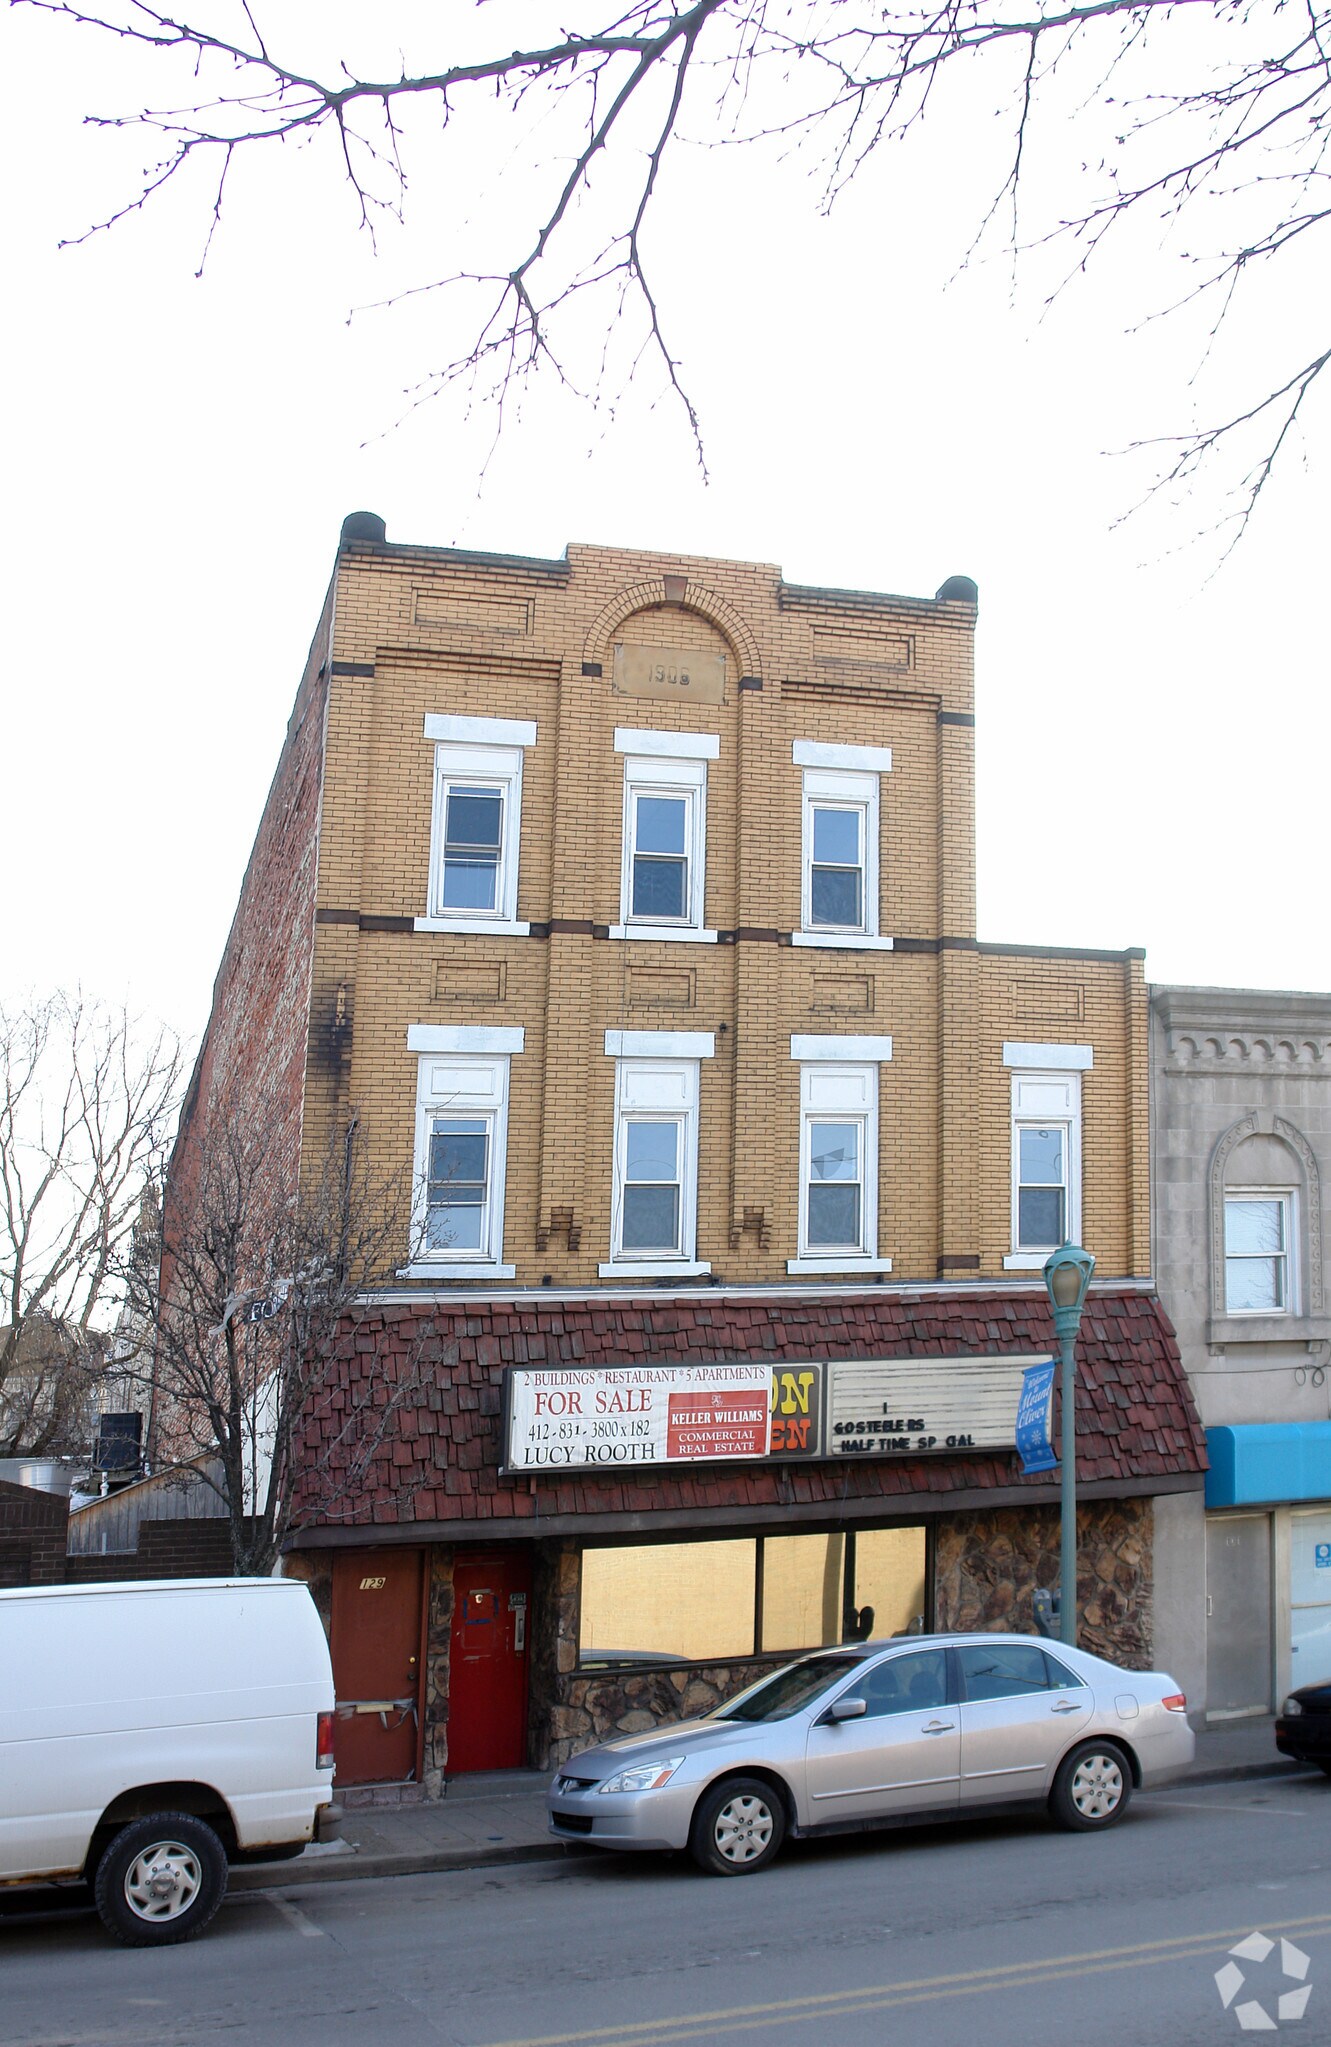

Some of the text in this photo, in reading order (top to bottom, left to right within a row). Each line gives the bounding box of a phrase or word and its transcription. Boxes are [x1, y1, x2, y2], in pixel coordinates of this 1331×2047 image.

[524, 1366, 766, 1386] 2 BUILDINGS RESTAURANT 5 APARTMENTS
[534, 1388, 653, 1416] FOR SALE
[1021, 1382, 1052, 1411] Mount
[671, 1410, 763, 1425] KELLER WILLIAMS
[678, 1430, 756, 1443] COMMERCIAL
[678, 1442, 755, 1454] REAL ESTATE
[841, 1439, 876, 1452] HALF
[523, 1442, 656, 1465] LUCY ROOTH
[362, 1578, 384, 1589] 129
